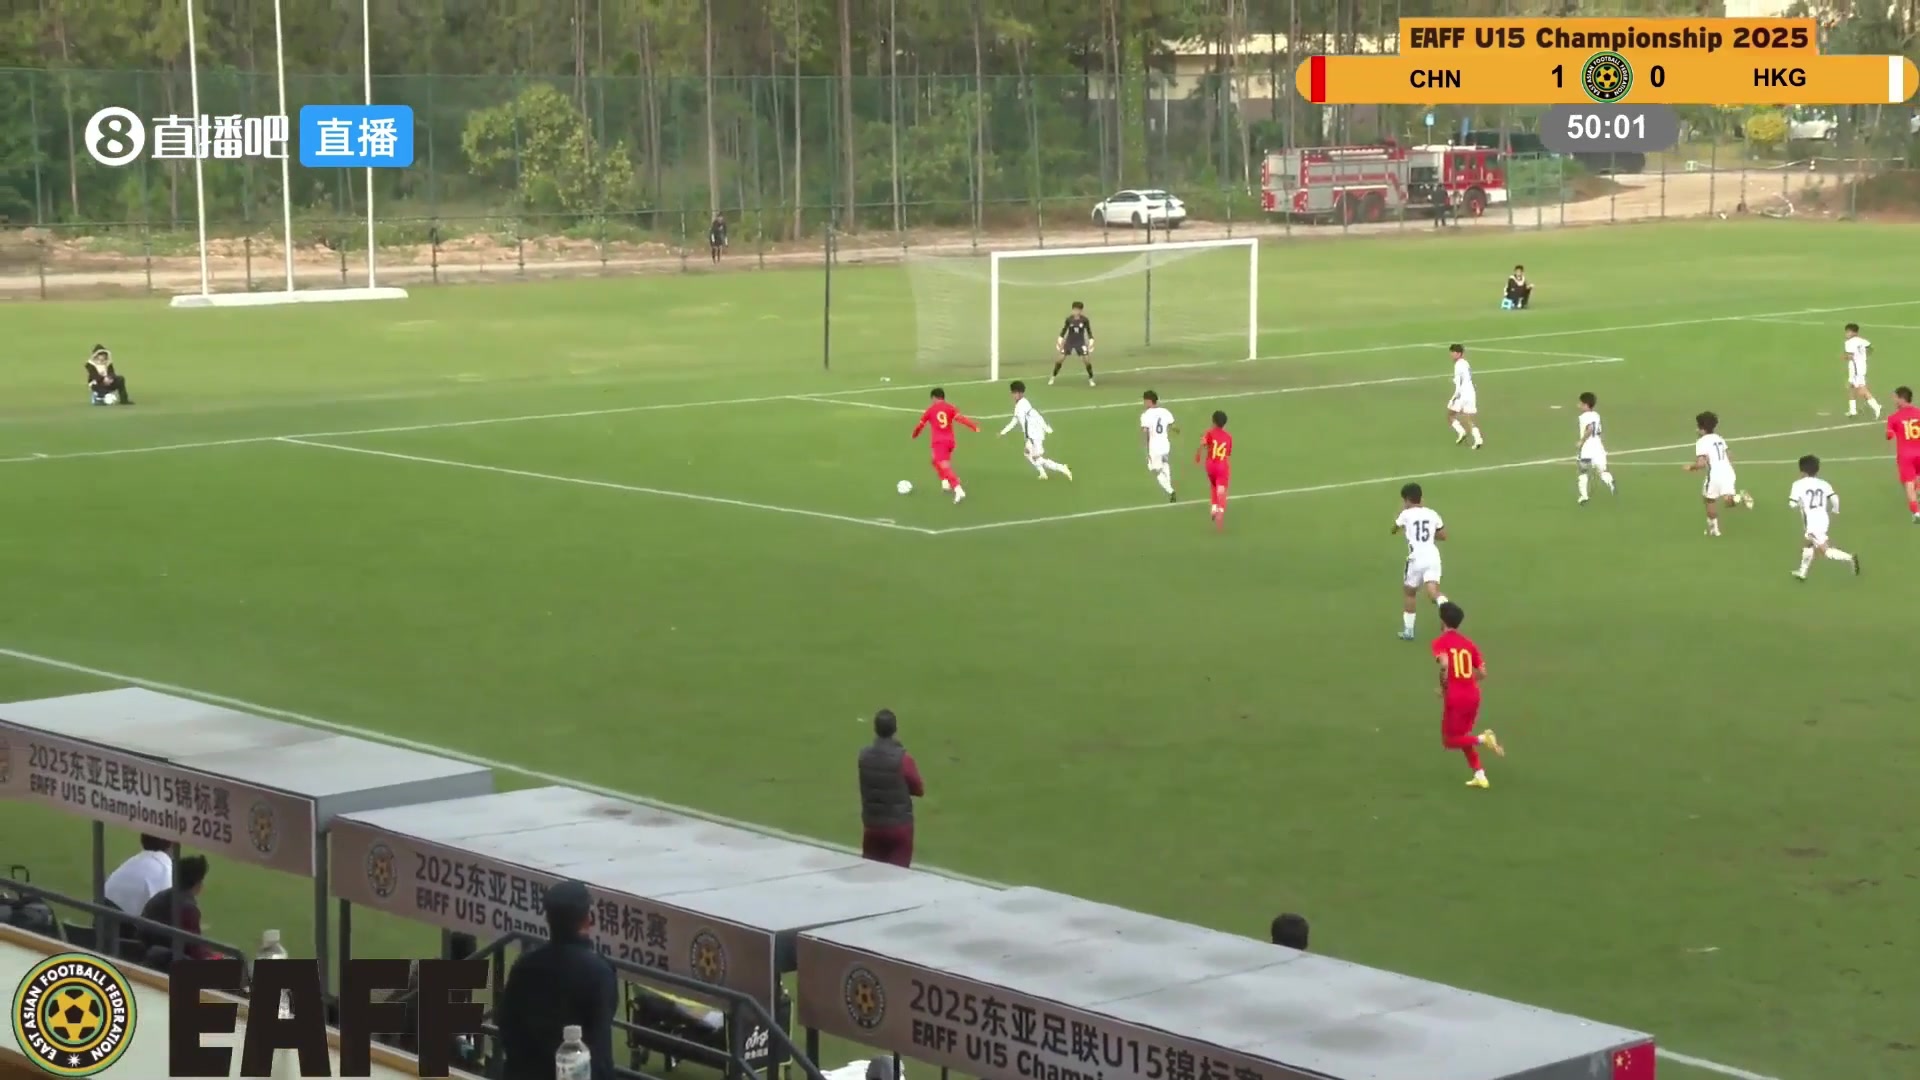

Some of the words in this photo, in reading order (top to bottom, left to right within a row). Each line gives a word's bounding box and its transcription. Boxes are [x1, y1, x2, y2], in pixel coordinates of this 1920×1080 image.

[936, 412, 948, 429] 9
[1155, 417, 1164, 435] 6
[1901, 418, 1920, 440] 16
[1211, 439, 1227, 461] 14
[1413, 519, 1430, 542] 15
[1449, 647, 1473, 679] 10
[61, 781, 86, 805] U15
[91, 789, 187, 837] Championship
[192, 815, 233, 844] 2025
[415, 851, 669, 951] 2025东亚足联锦标赛
[416, 885, 449, 916] EAFF
[455, 896, 487, 925] U15
[912, 1018, 957, 1053] EAFF
[965, 1033, 1009, 1069] U15
